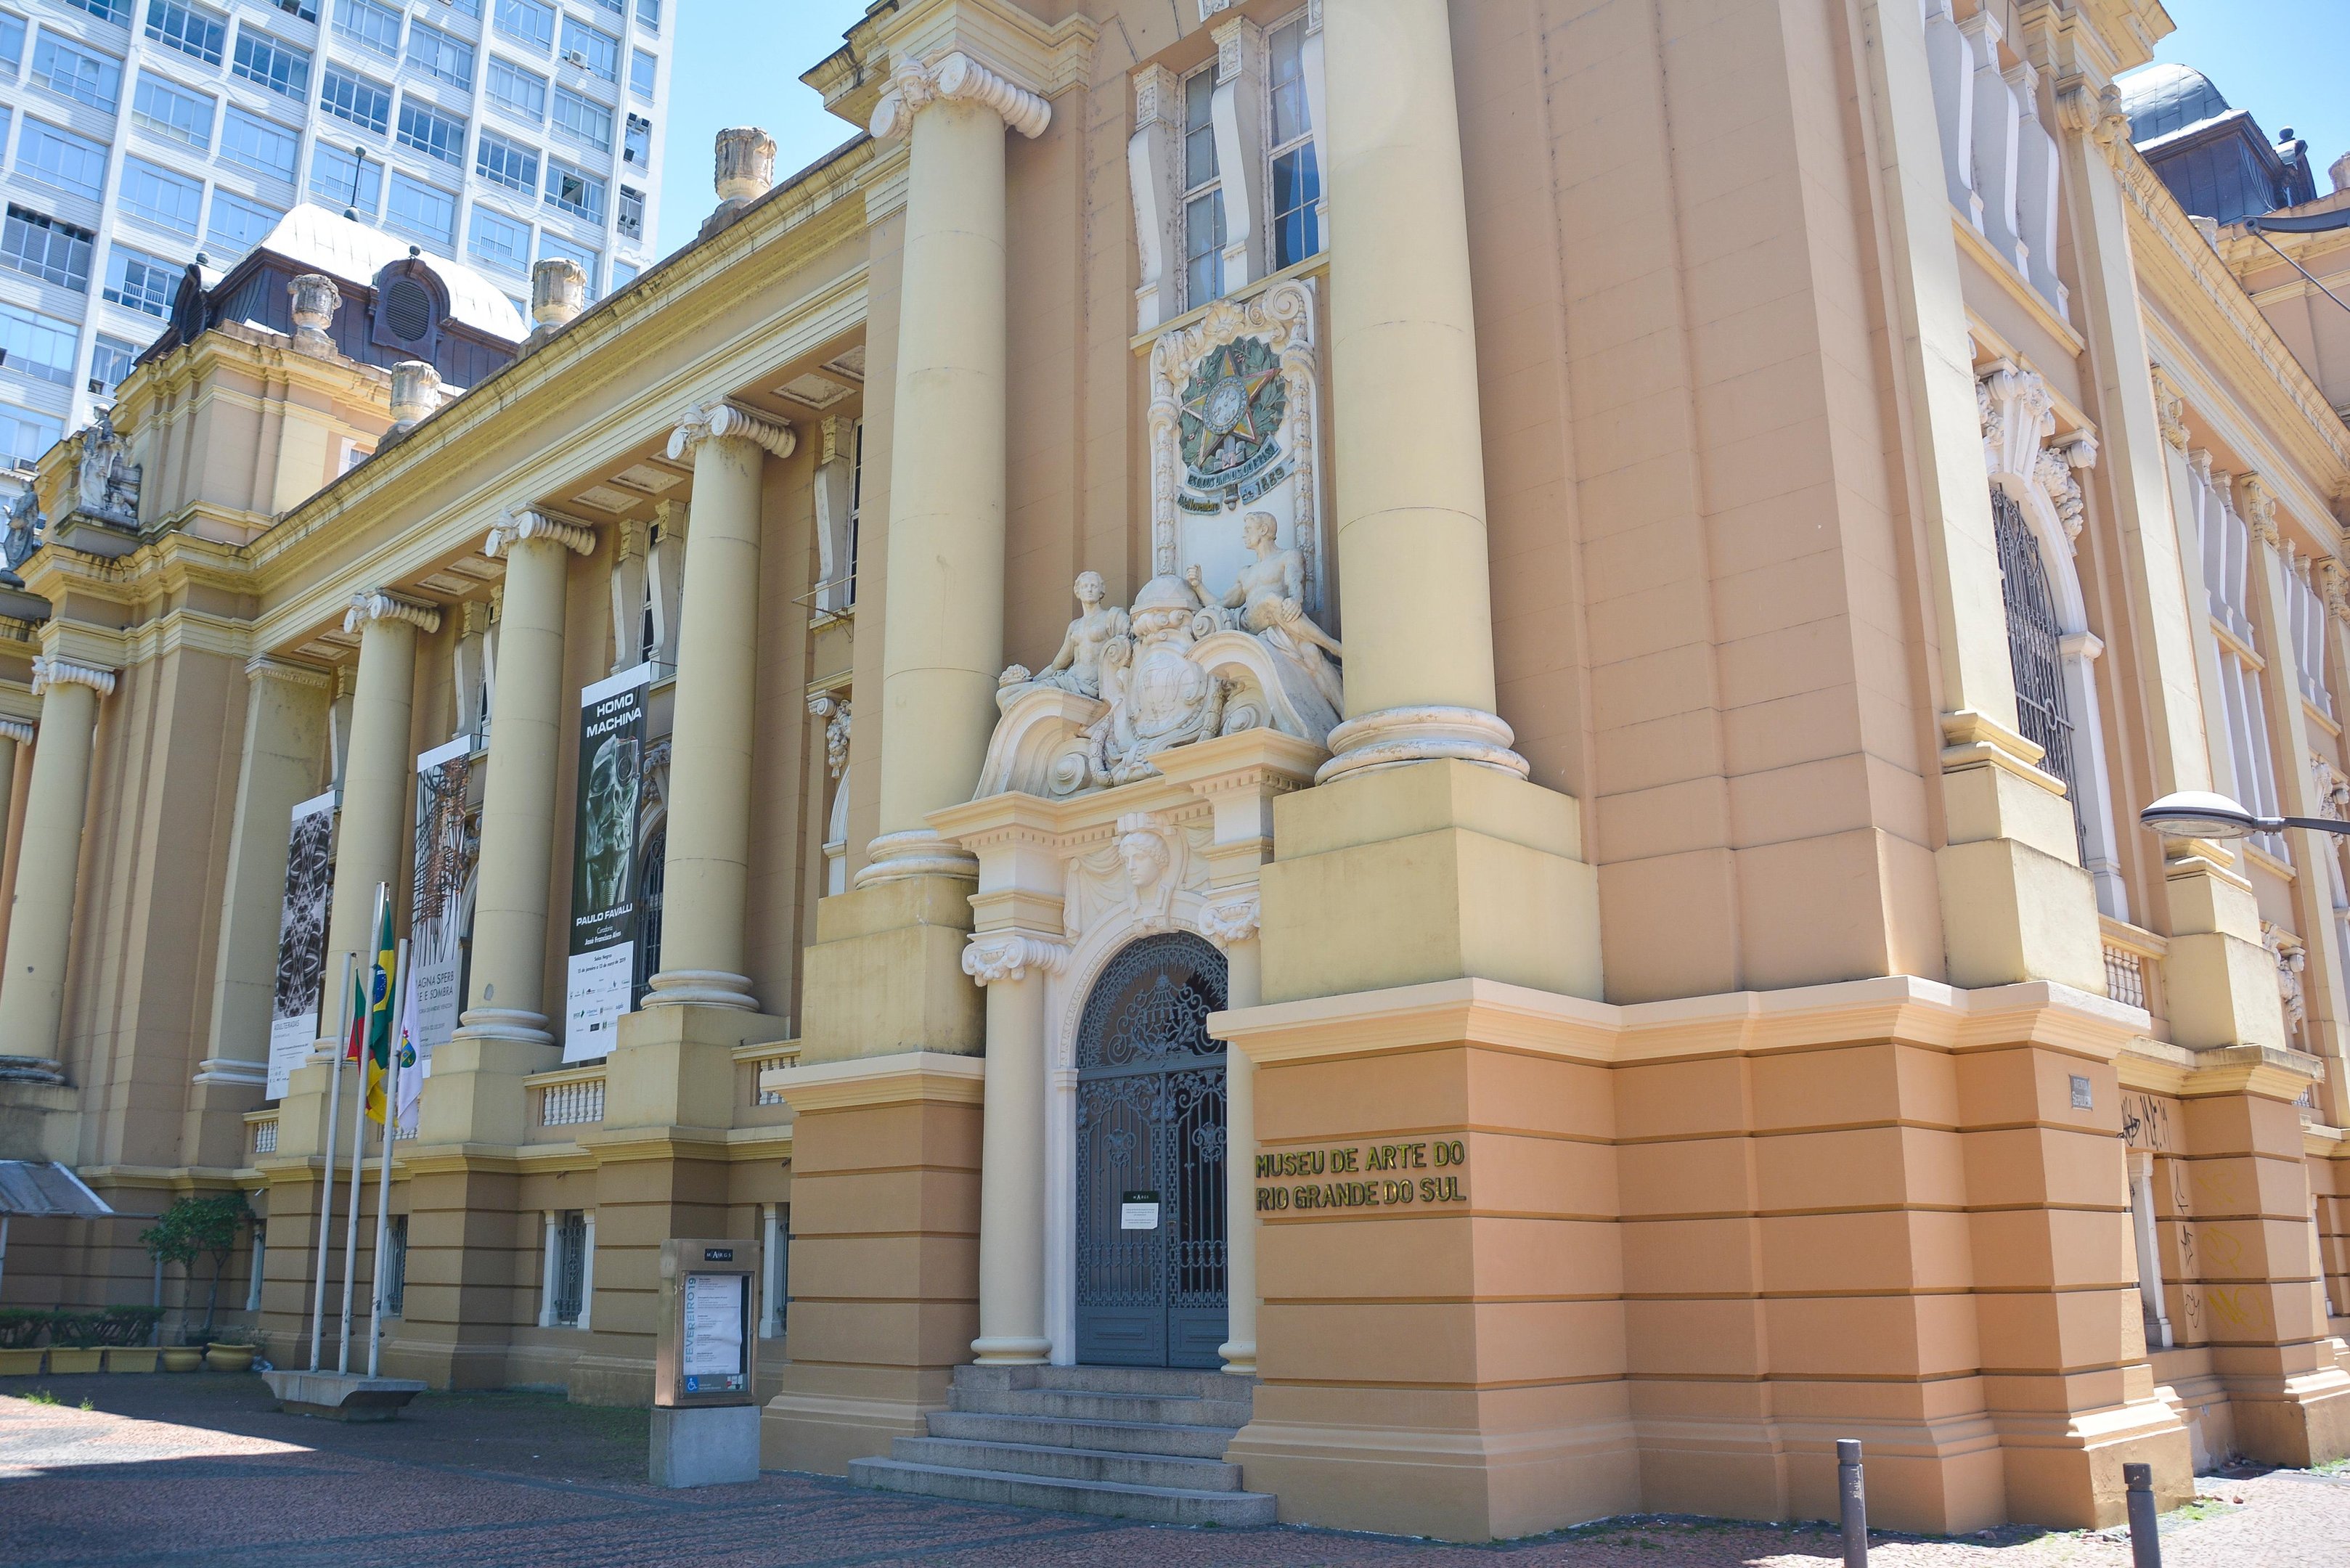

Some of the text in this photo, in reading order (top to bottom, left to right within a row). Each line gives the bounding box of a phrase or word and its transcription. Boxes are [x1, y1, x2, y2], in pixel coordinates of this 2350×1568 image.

[1241, 467, 1285, 500] de 1889
[597, 693, 634, 717] HOMO
[587, 707, 642, 738] MACHINA
[576, 902, 633, 926] PAULO FAVALLI
[436, 971, 454, 984] SPERB
[425, 990, 429, 1000] E
[430, 986, 453, 1000] SOMBRA
[1256, 1140, 1465, 1177] MUSEU DE ARTE DO
[1256, 1176, 1466, 1211] RIO GRANDE DO SUL
